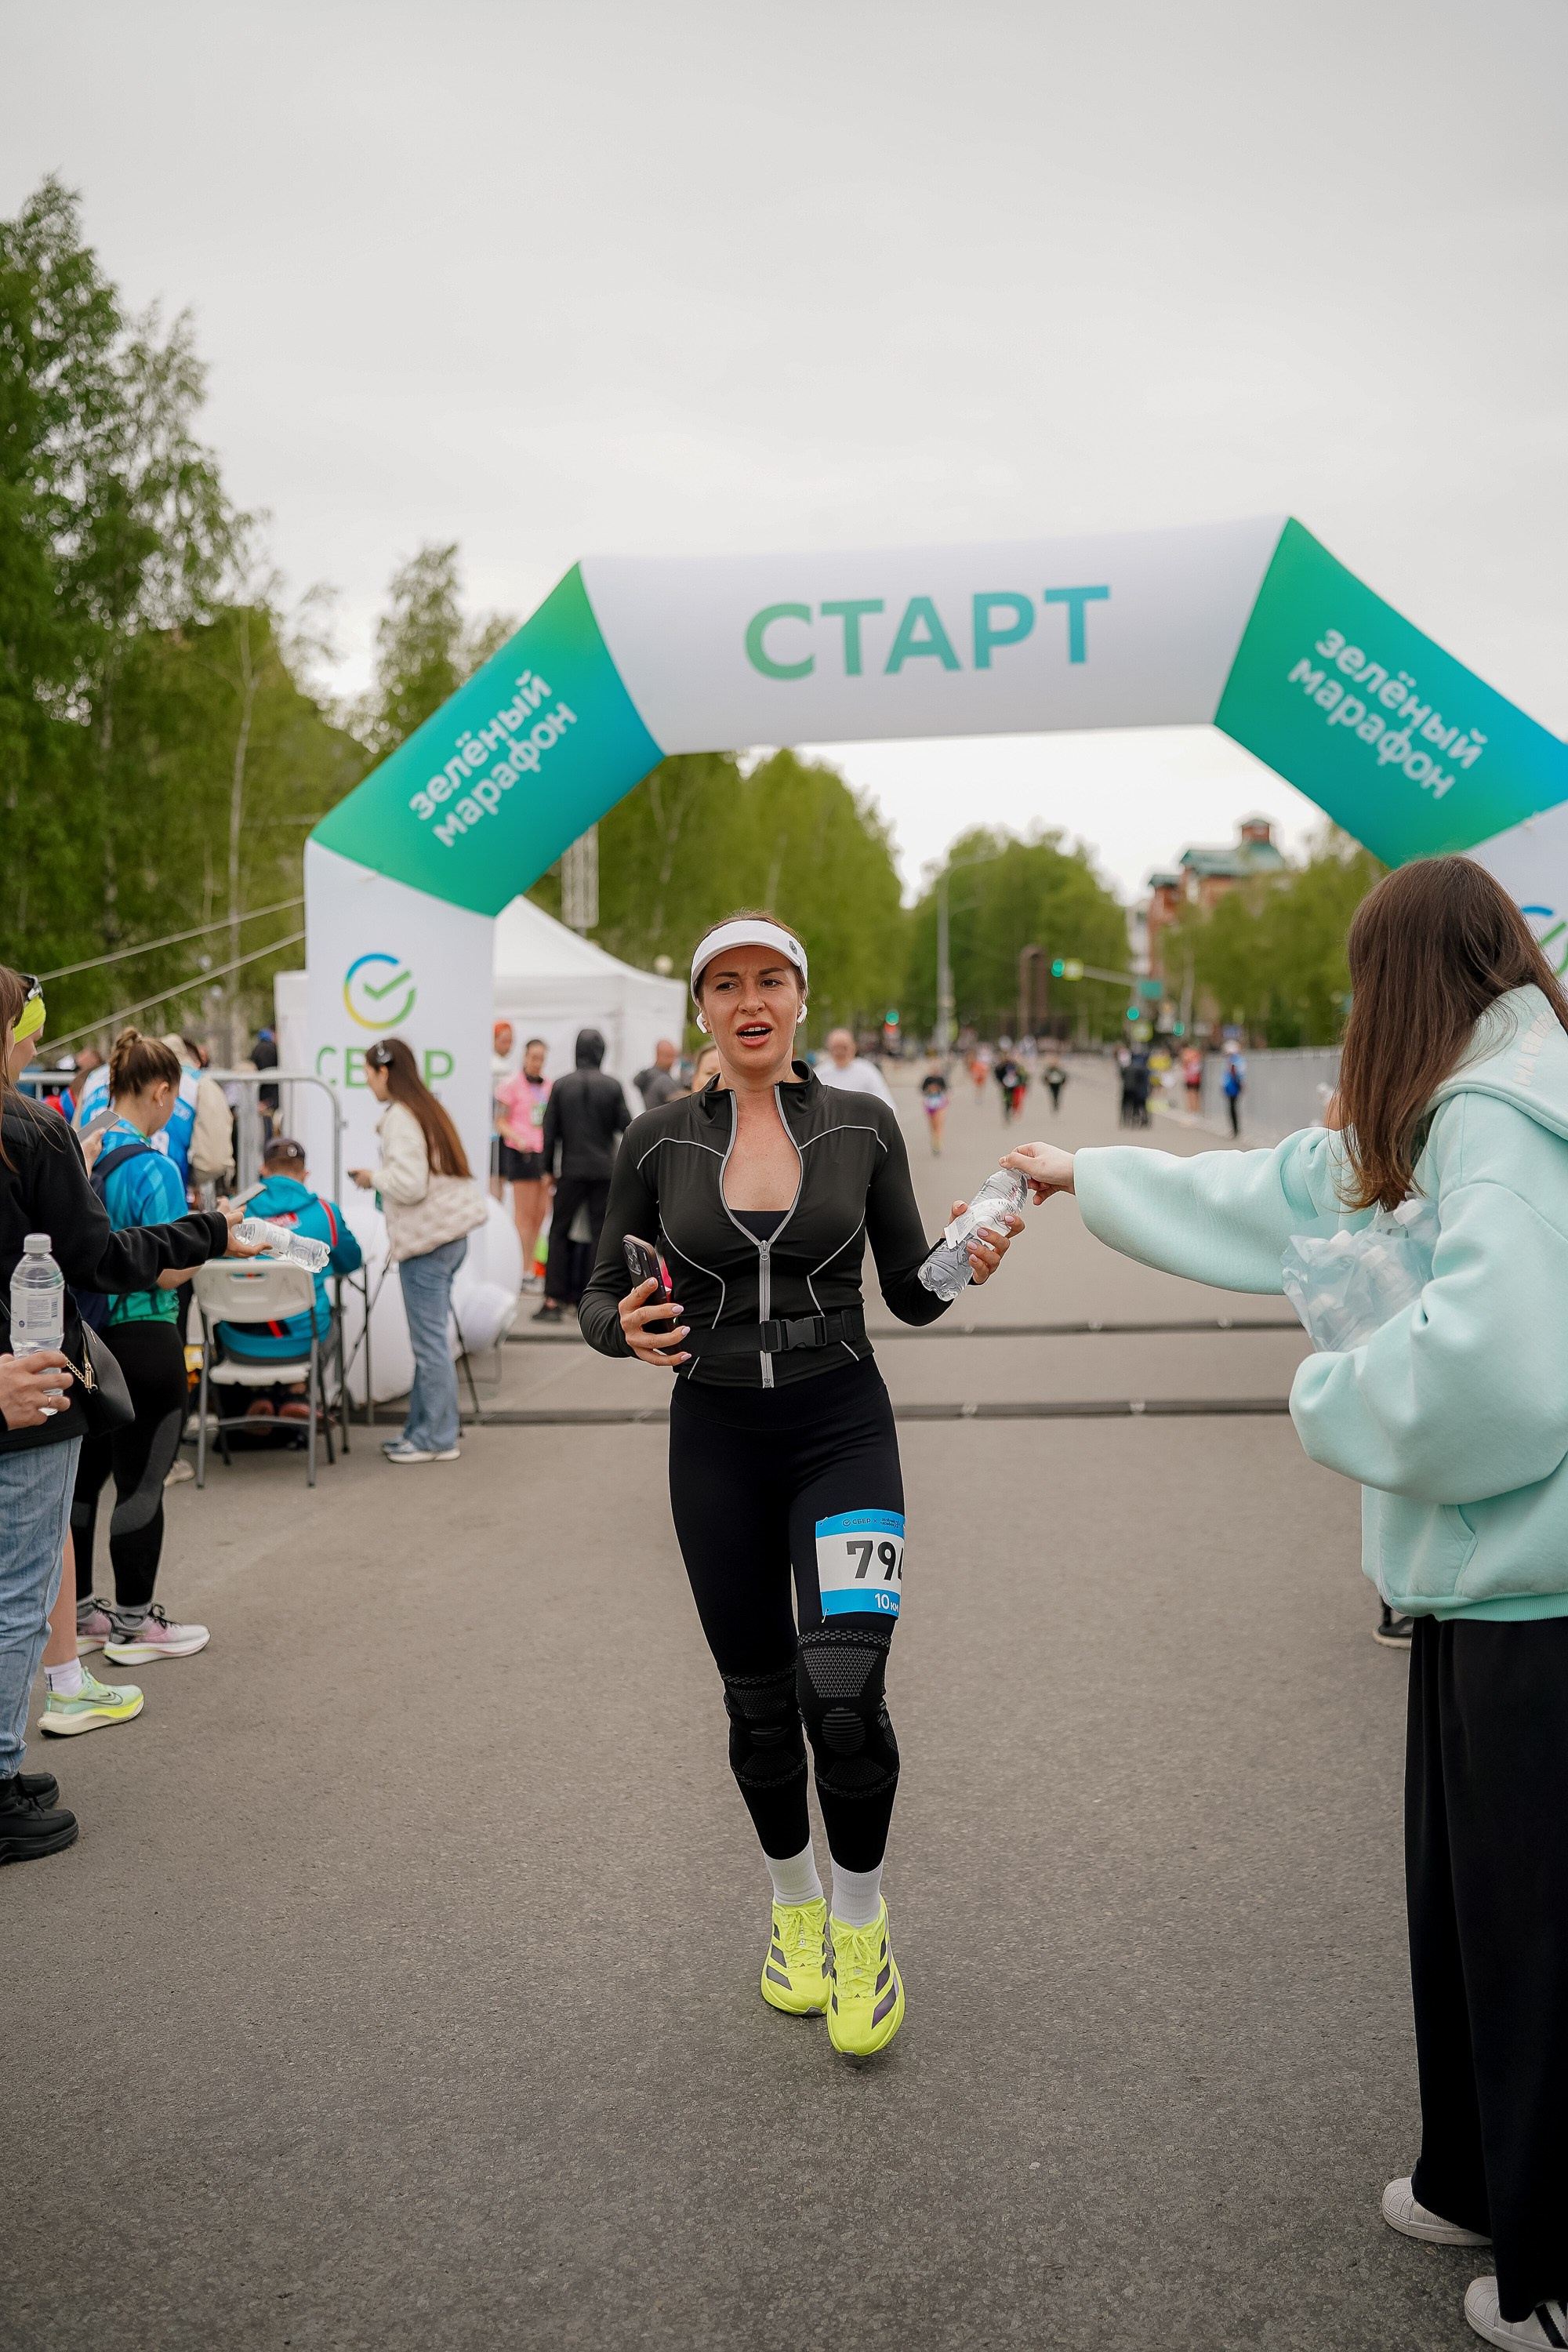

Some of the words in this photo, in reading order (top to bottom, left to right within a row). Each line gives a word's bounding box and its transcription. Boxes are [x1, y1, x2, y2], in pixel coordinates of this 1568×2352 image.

[743, 583, 1111, 681] СТАРТ
[1315, 628, 1489, 770] зелёный
[408, 668, 553, 821] зелёный
[430, 700, 579, 848] марафон
[1287, 657, 1457, 800] марафон
[316, 1046, 455, 1091] СБР
[874, 1592, 890, 1610] 10
